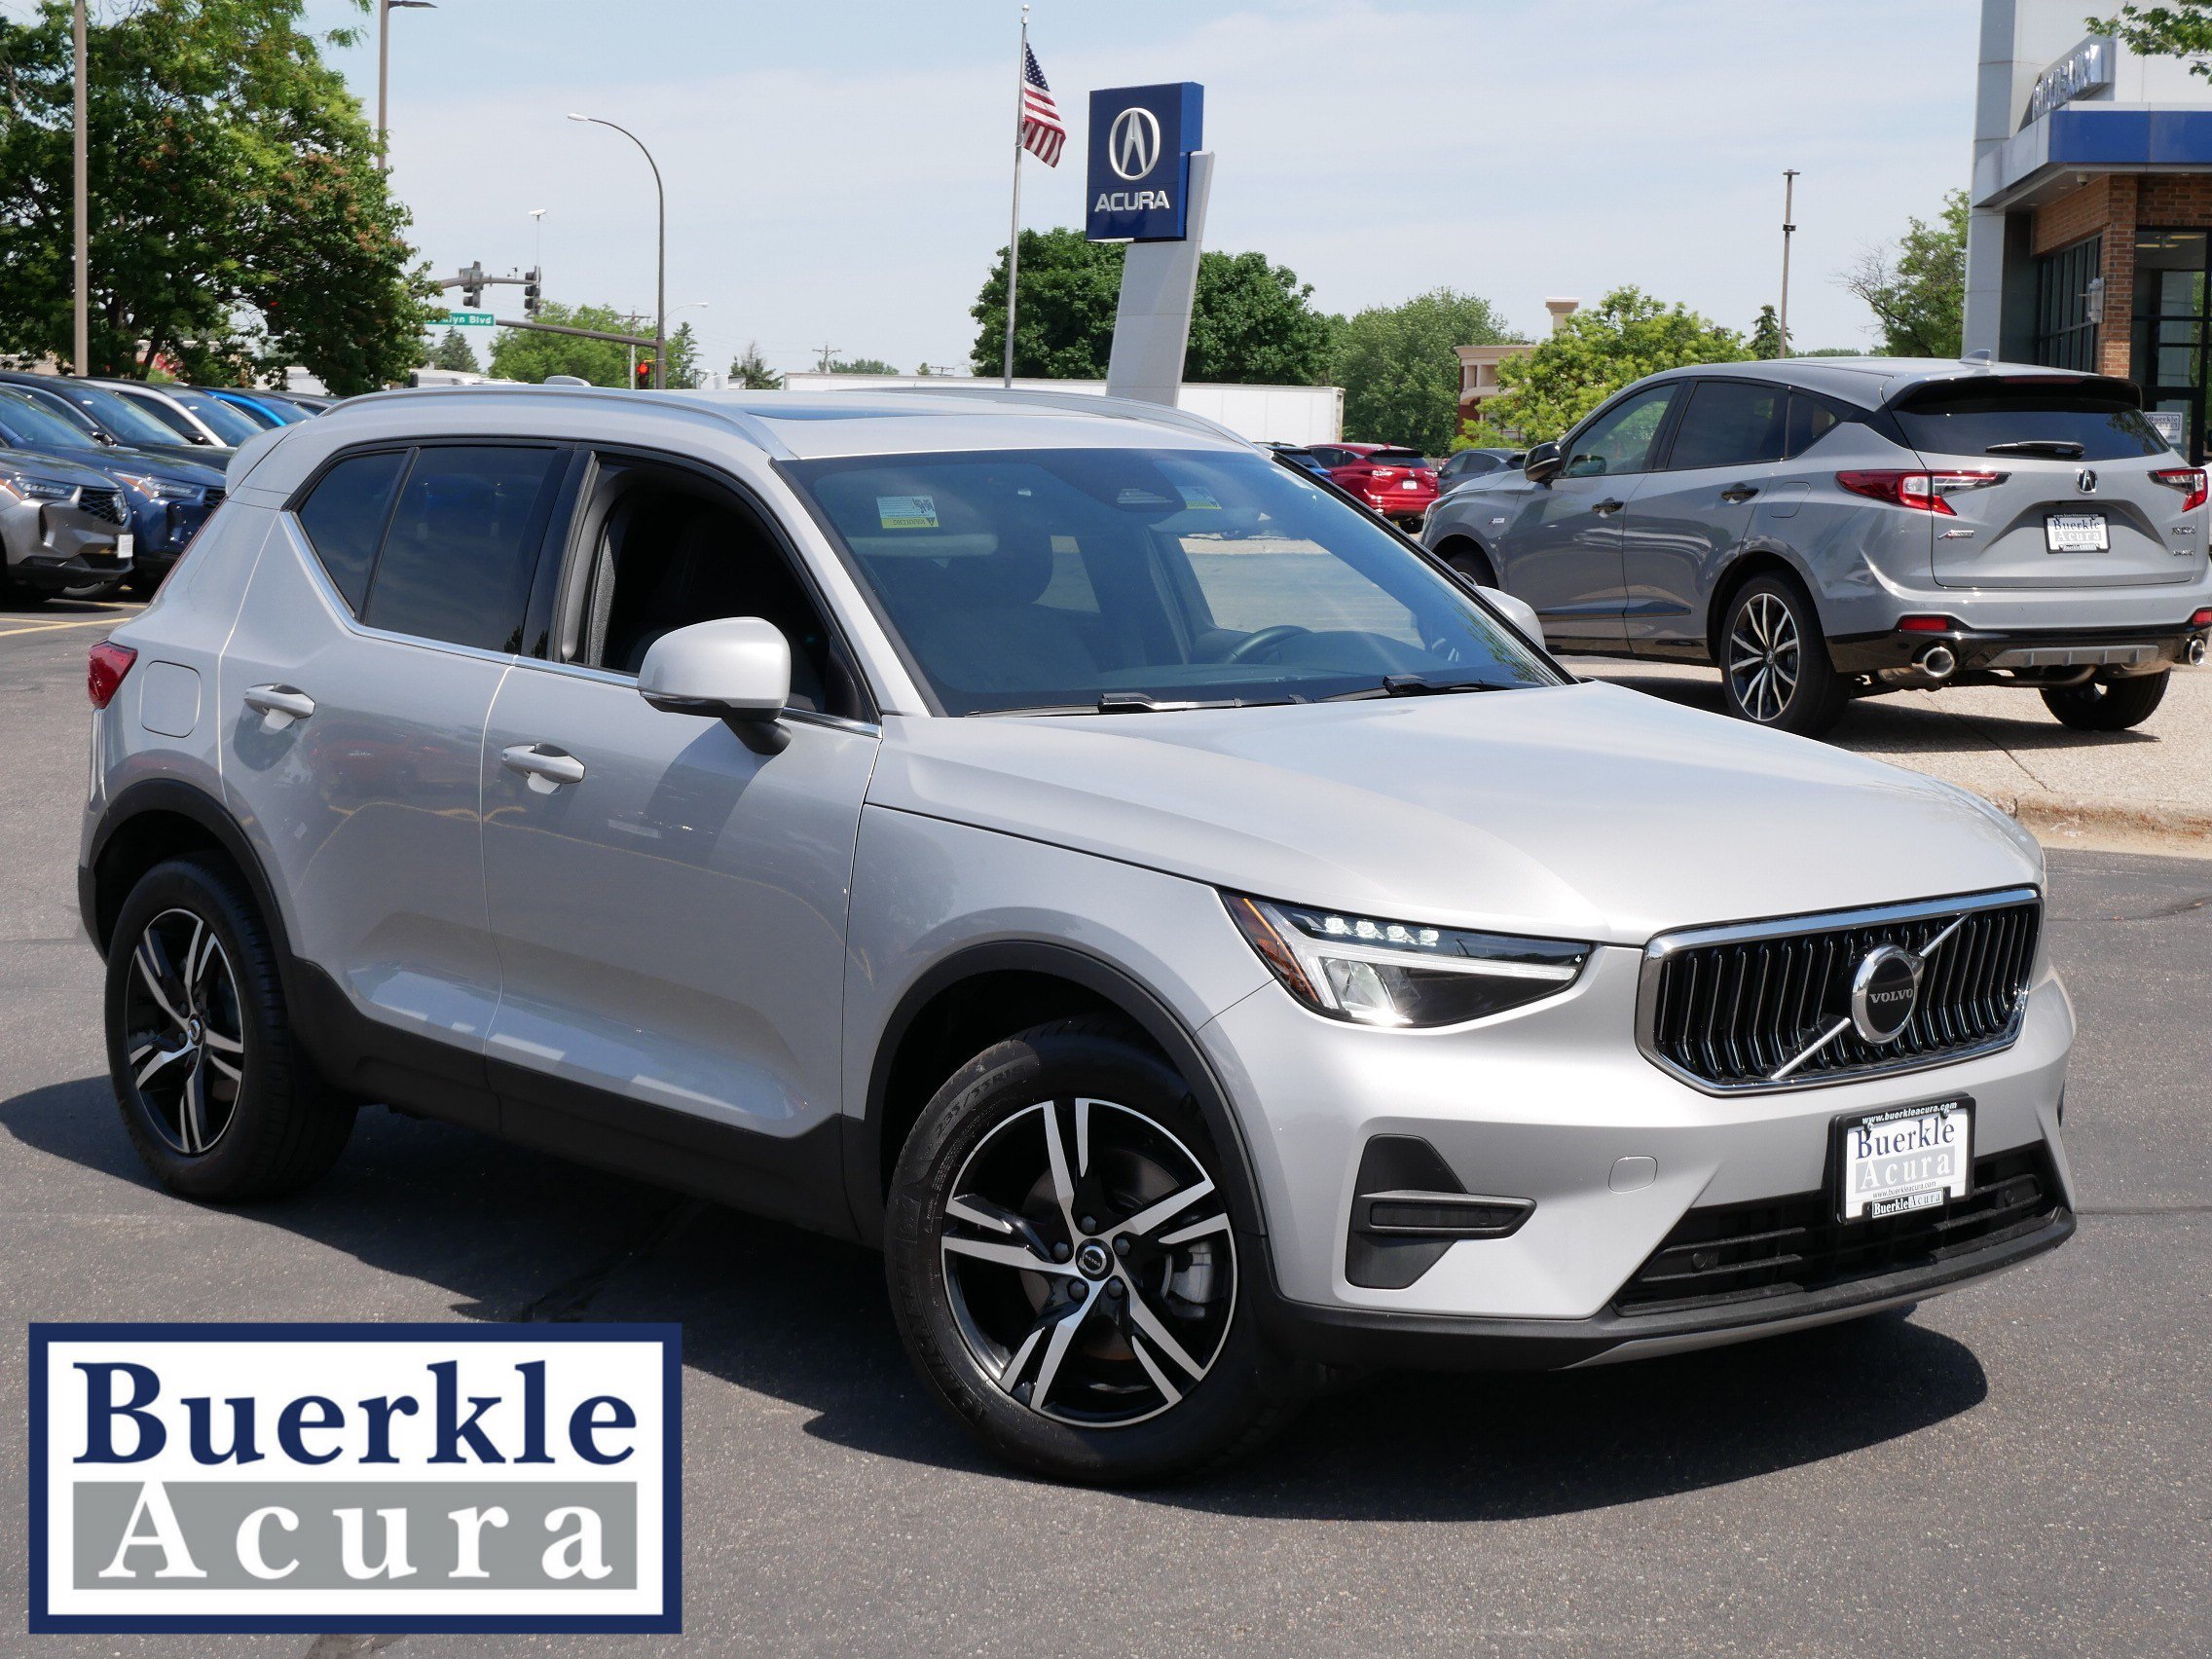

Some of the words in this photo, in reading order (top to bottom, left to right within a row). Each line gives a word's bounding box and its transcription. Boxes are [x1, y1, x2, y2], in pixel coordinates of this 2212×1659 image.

[1094, 190, 1170, 212] ACURA
[468, 314, 493, 324] Blvd
[2052, 519, 2100, 531] Buerkle
[2057, 531, 2100, 541] Acura
[1868, 987, 1914, 1004] VOLVO
[1862, 1101, 1958, 1125] www.buerkleacura.com
[1855, 1116, 1955, 1161] Buerkle
[1860, 1152, 1951, 1191] Acura
[1872, 1180, 1937, 1198] www.buerkleacura.com
